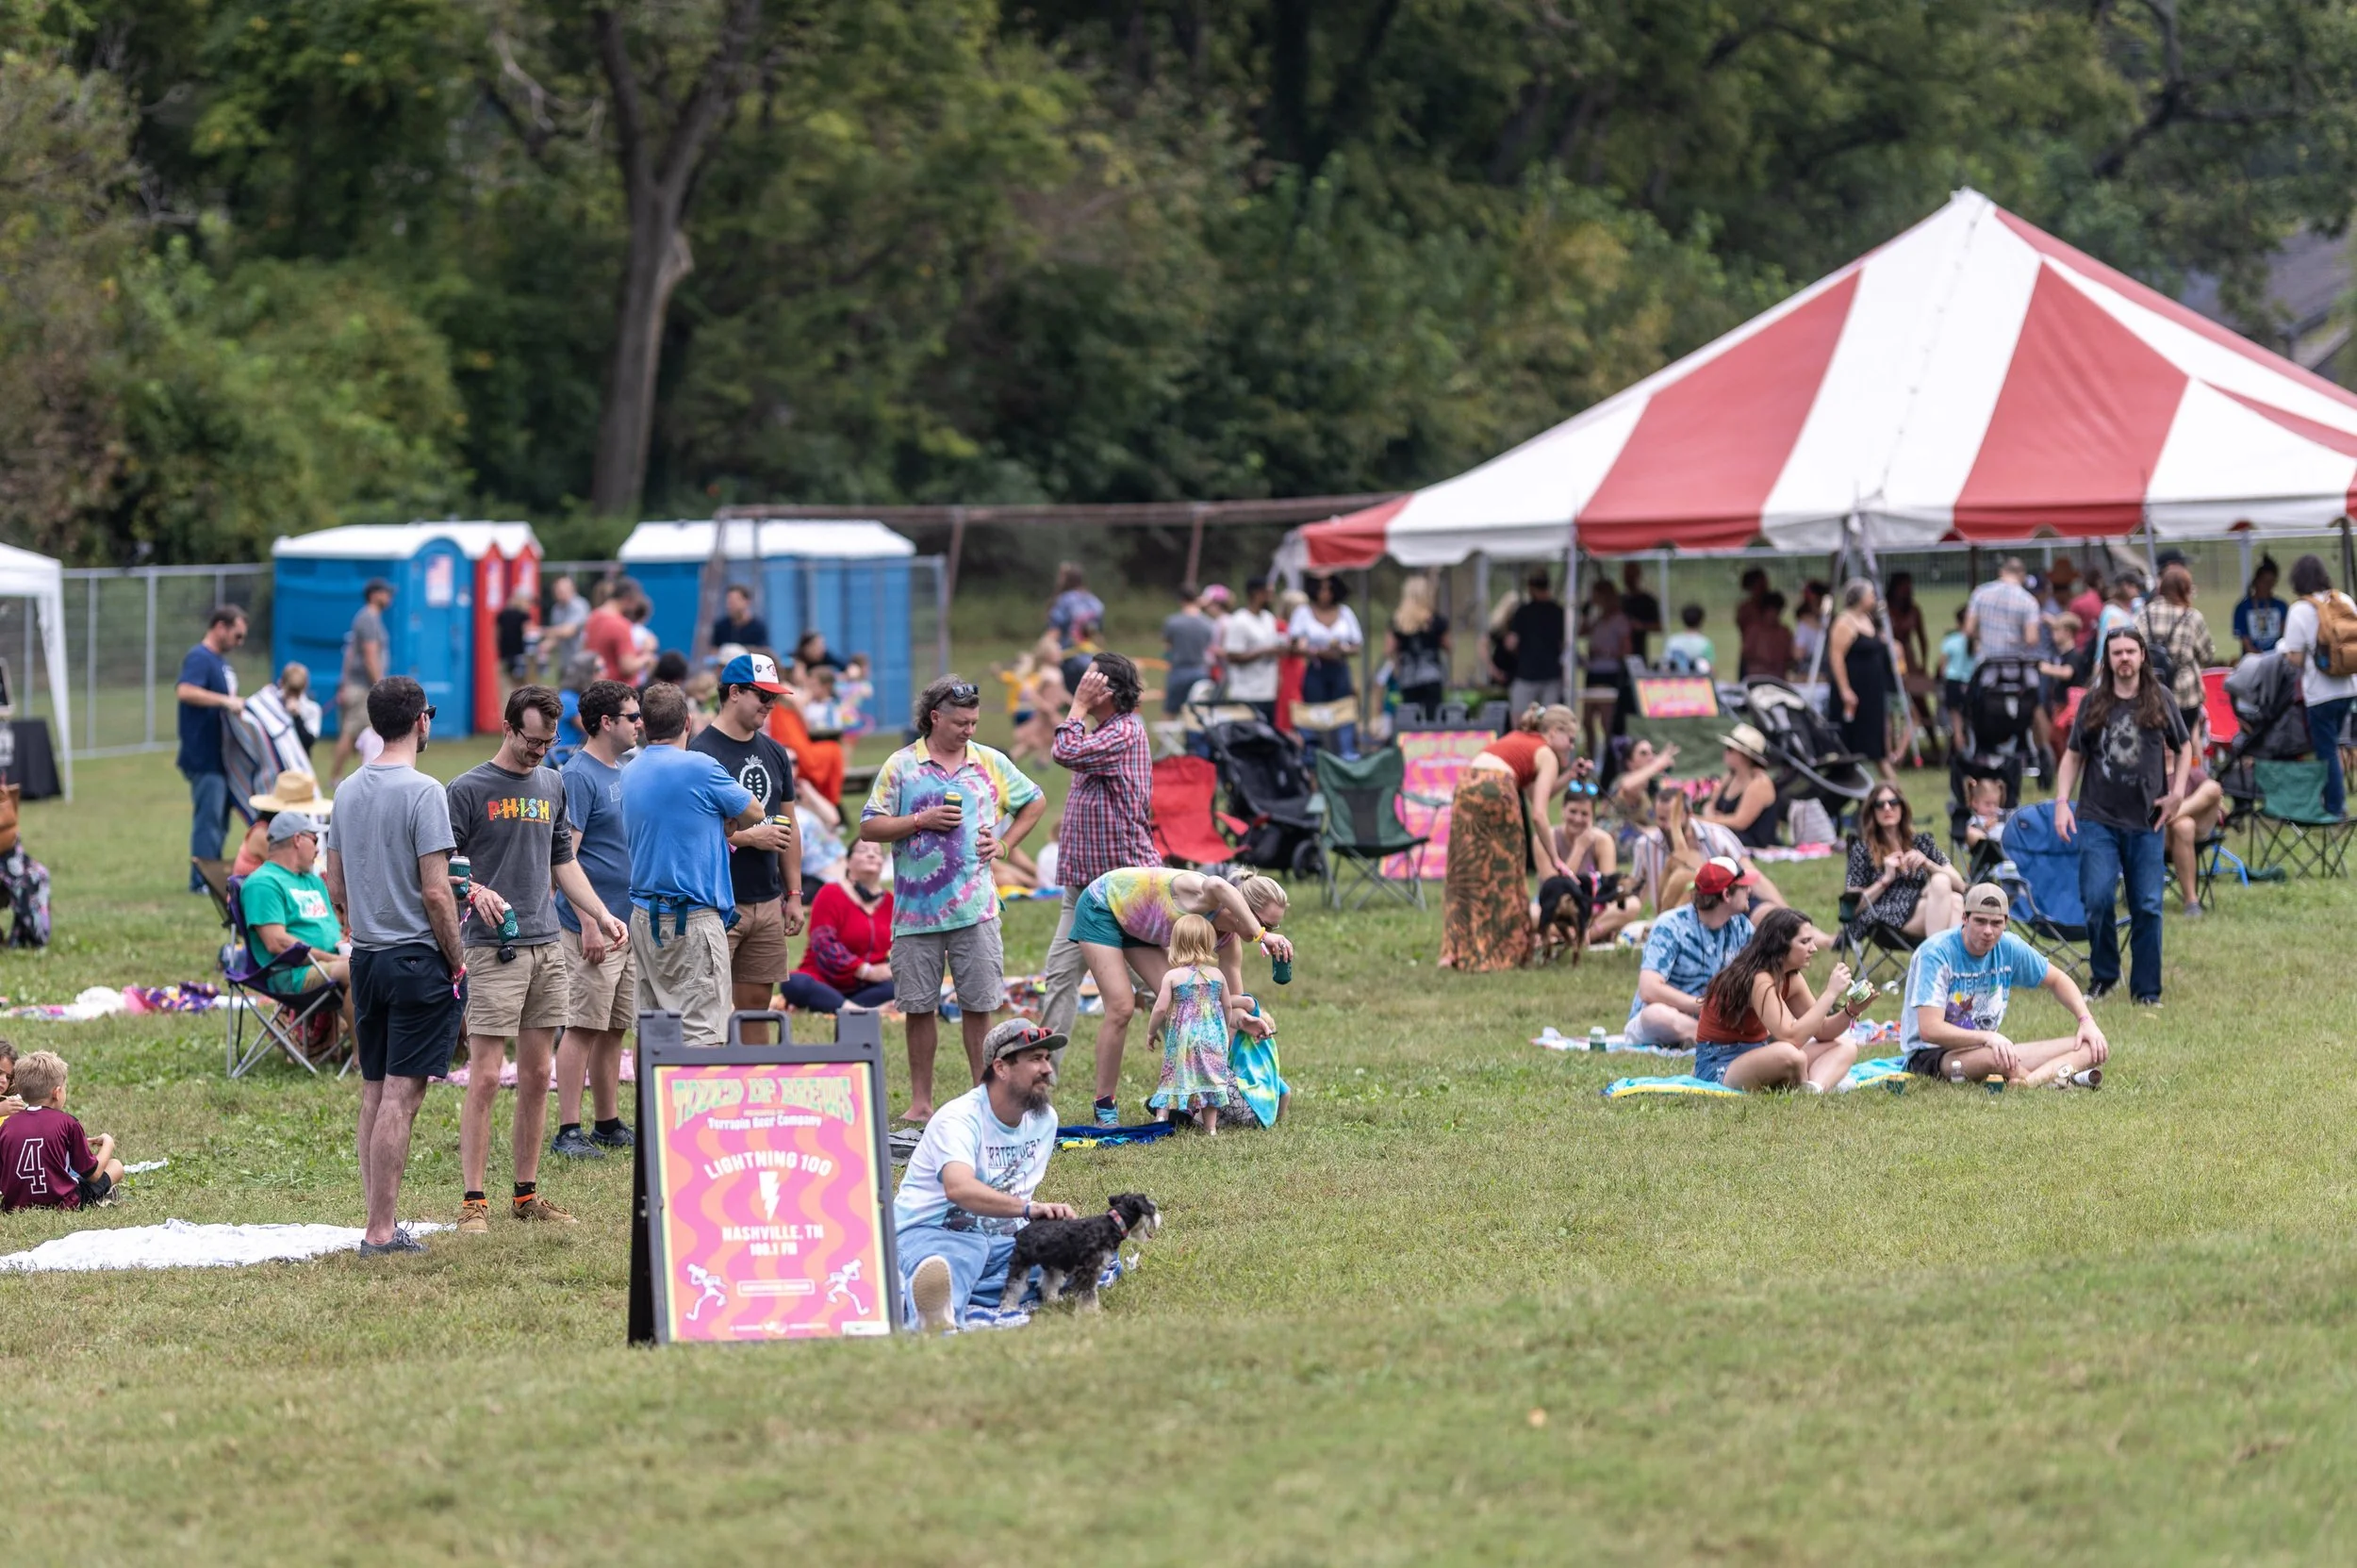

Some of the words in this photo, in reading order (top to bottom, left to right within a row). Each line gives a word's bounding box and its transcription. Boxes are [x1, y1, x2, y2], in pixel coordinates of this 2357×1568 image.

[487, 797, 550, 821] PHISH
[16, 1138, 47, 1195] 4
[704, 1149, 798, 1180] LIGHTNING
[801, 1154, 832, 1176] 100
[805, 1224, 824, 1239] TN
